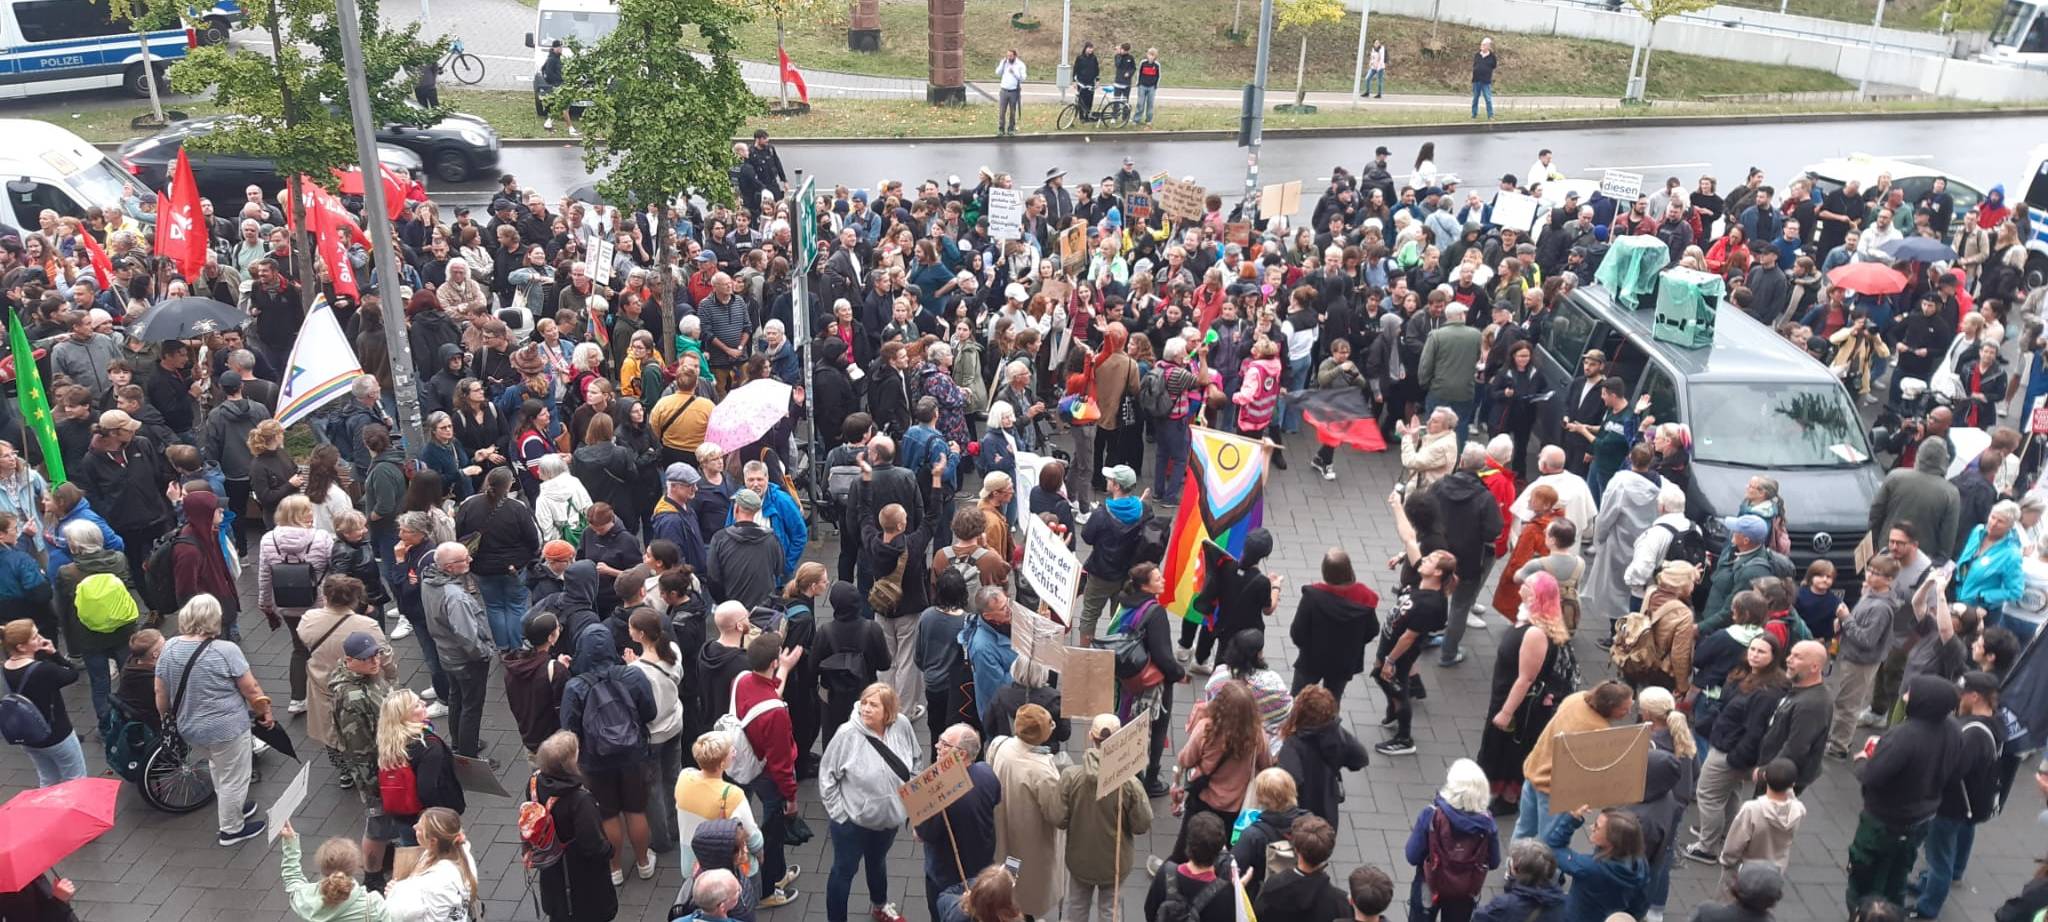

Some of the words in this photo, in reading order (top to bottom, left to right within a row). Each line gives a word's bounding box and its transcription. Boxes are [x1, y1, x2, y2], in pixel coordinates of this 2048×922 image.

[40, 55, 84, 68] POLIZEI
[1604, 181, 1638, 195] diesen
[1032, 527, 1044, 552] Nicht
[1044, 547, 1057, 561] nur
[1057, 556, 1071, 573] der
[1045, 562, 1054, 578] ist
[1055, 569, 1067, 586] ein
